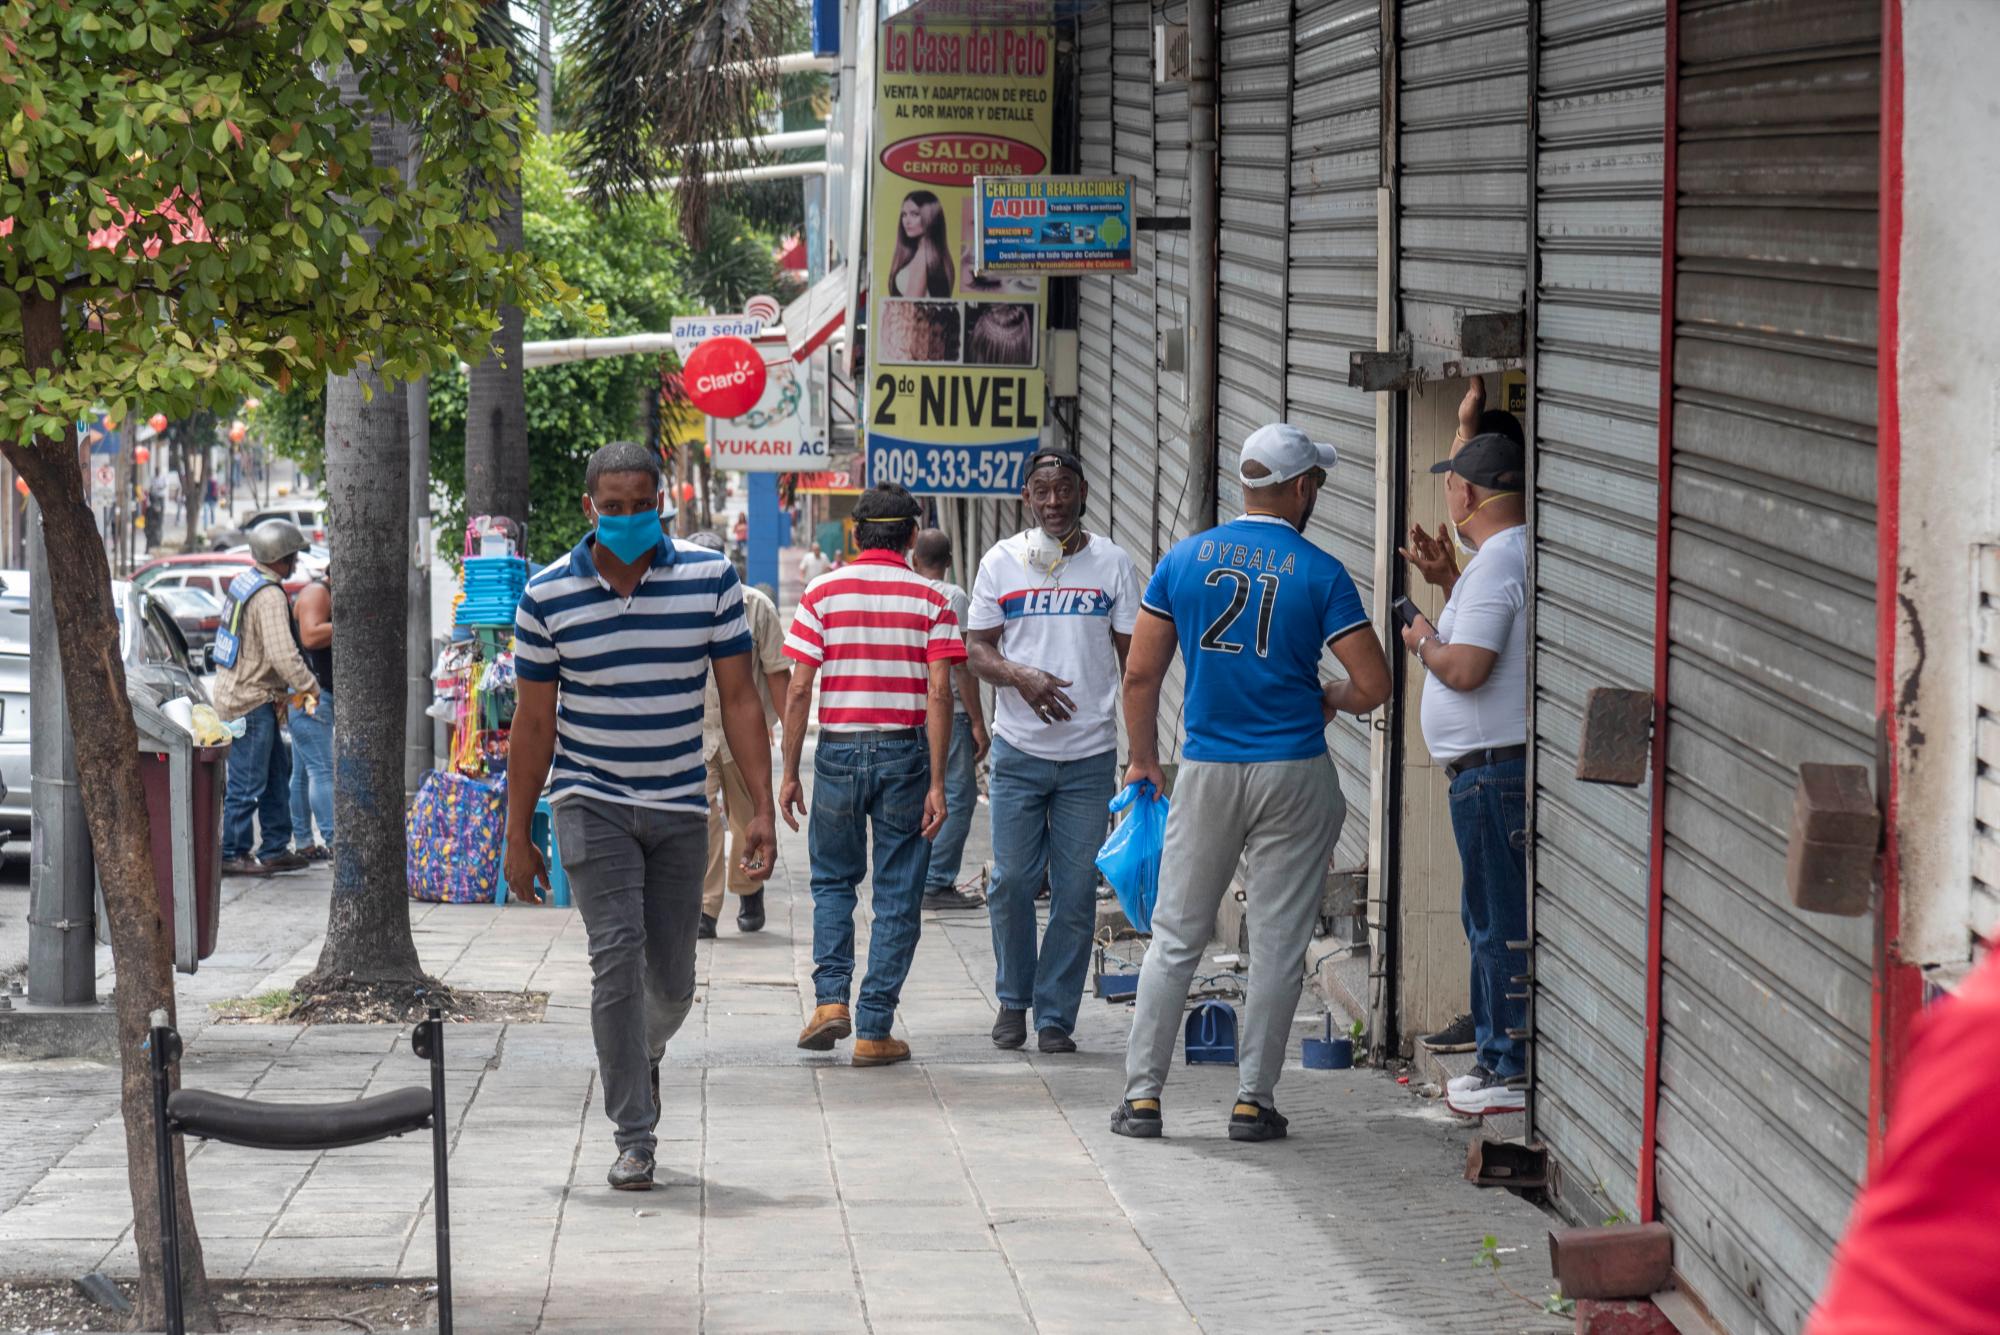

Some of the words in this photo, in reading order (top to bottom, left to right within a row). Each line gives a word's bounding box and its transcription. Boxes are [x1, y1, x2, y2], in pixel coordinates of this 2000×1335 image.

[885, 24, 907, 74] La
[912, 25, 962, 74] Casa
[966, 26, 998, 75] del
[1003, 28, 1048, 77] Pelo
[884, 85, 919, 99] VENTA
[922, 86, 930, 99] Y
[932, 86, 999, 101] ADAPTACION
[1003, 88, 1017, 102] DE
[1020, 89, 1047, 103] PELO
[896, 105, 909, 118] AL
[912, 105, 935, 119] POR
[938, 106, 974, 120] MAYOR
[977, 107, 985, 121] Y
[988, 107, 1034, 121] DETALLE
[918, 141, 1009, 160] SALON
[903, 161, 958, 175] CENTRO
[963, 162, 980, 175] DE
[985, 160, 1022, 176] UÑAS
[986, 182, 1026, 198] CENTRO
[1031, 182, 1042, 197] DE
[1047, 181, 1125, 198] REPARACIONES
[991, 198, 1047, 220] AQUI
[999, 251, 1036, 260] Desblqueo
[676, 322, 706, 338] alta
[712, 319, 760, 337] señal
[697, 370, 747, 393] Claro
[920, 375, 1037, 428] NIVEL
[716, 439, 792, 456] YUKARI
[798, 440, 825, 456] AC
[873, 447, 1034, 489] 809-333-527
[1198, 540, 1296, 576] DYBALA
[1023, 590, 1097, 614] LEVI'S
[1200, 567, 1280, 658] 21
